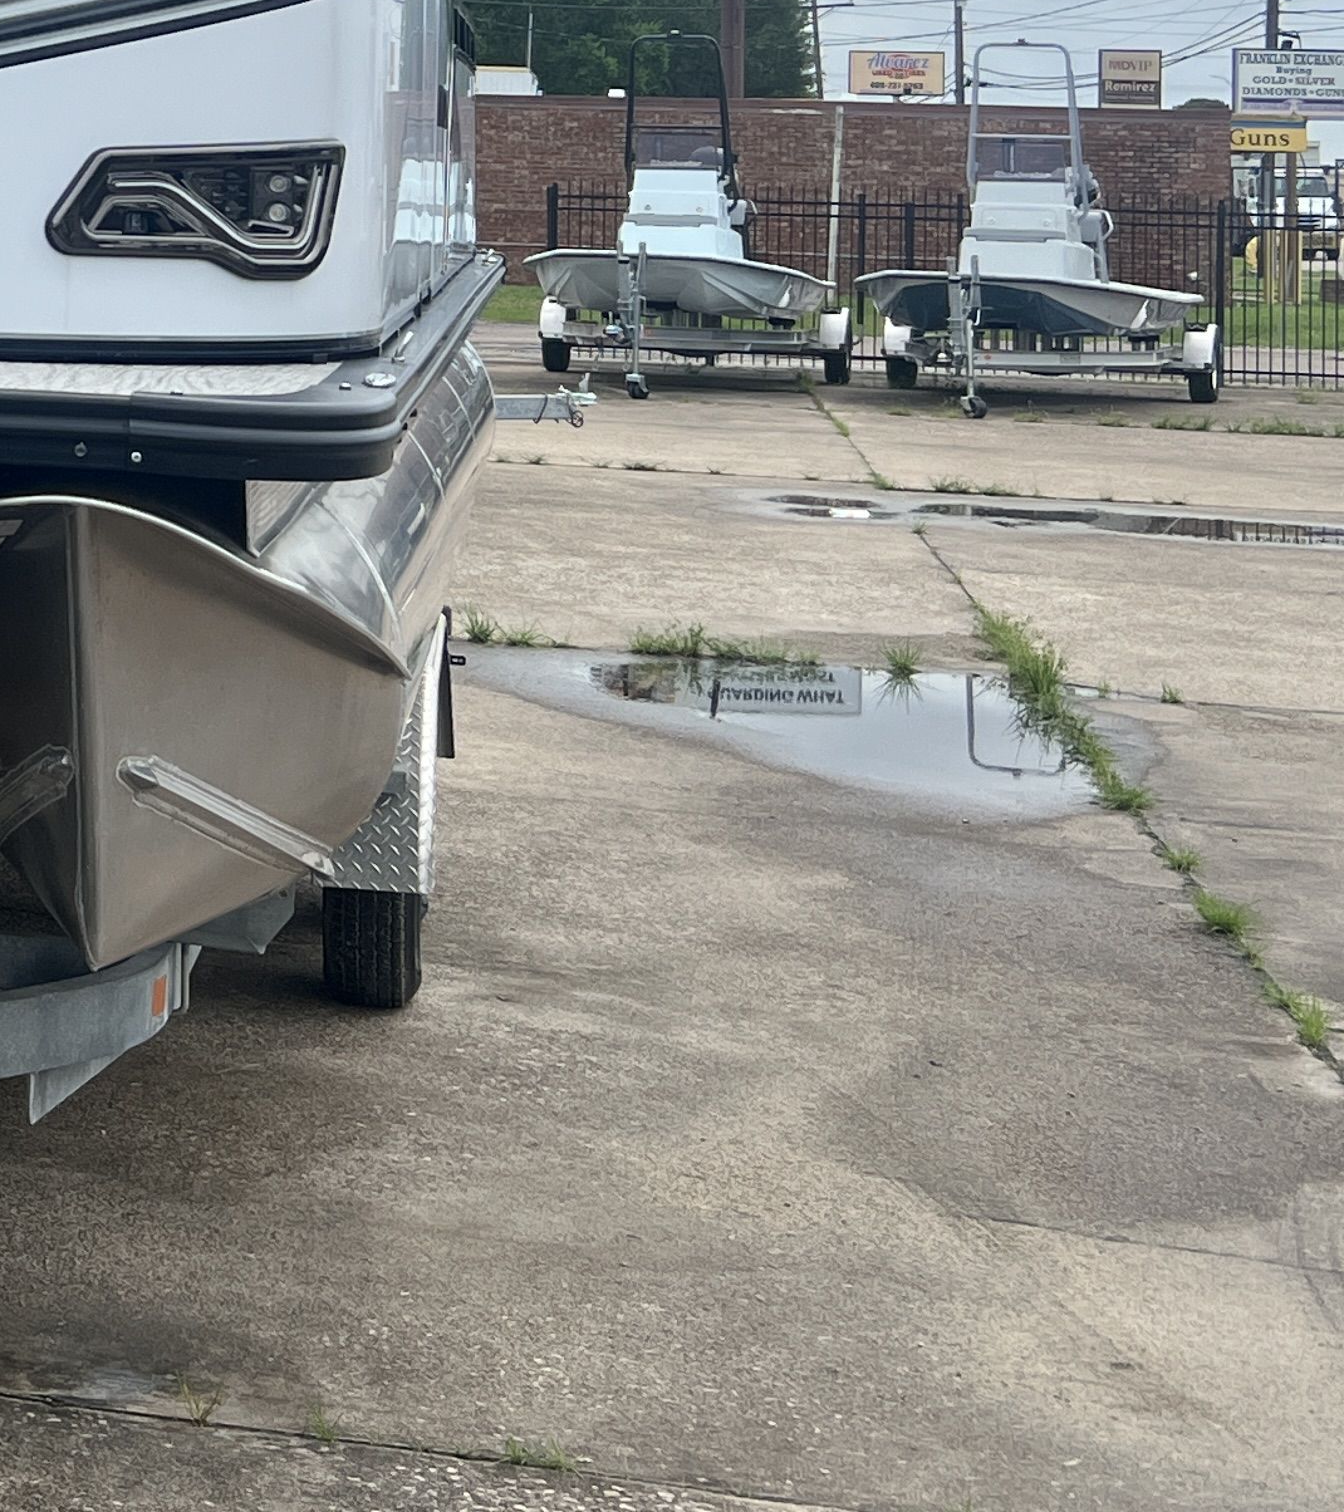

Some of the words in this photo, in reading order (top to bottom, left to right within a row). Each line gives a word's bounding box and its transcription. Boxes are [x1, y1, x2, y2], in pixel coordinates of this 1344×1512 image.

[1239, 53, 1290, 65] FRANKLIN
[1293, 54, 1344, 66] EXCHANG
[1275, 66, 1313, 76] Buying
[1252, 76, 1287, 85] GOLD
[1295, 76, 1336, 86] SILVER
[1242, 87, 1308, 97] DIAMONDS
[1230, 128, 1291, 147] Guns
